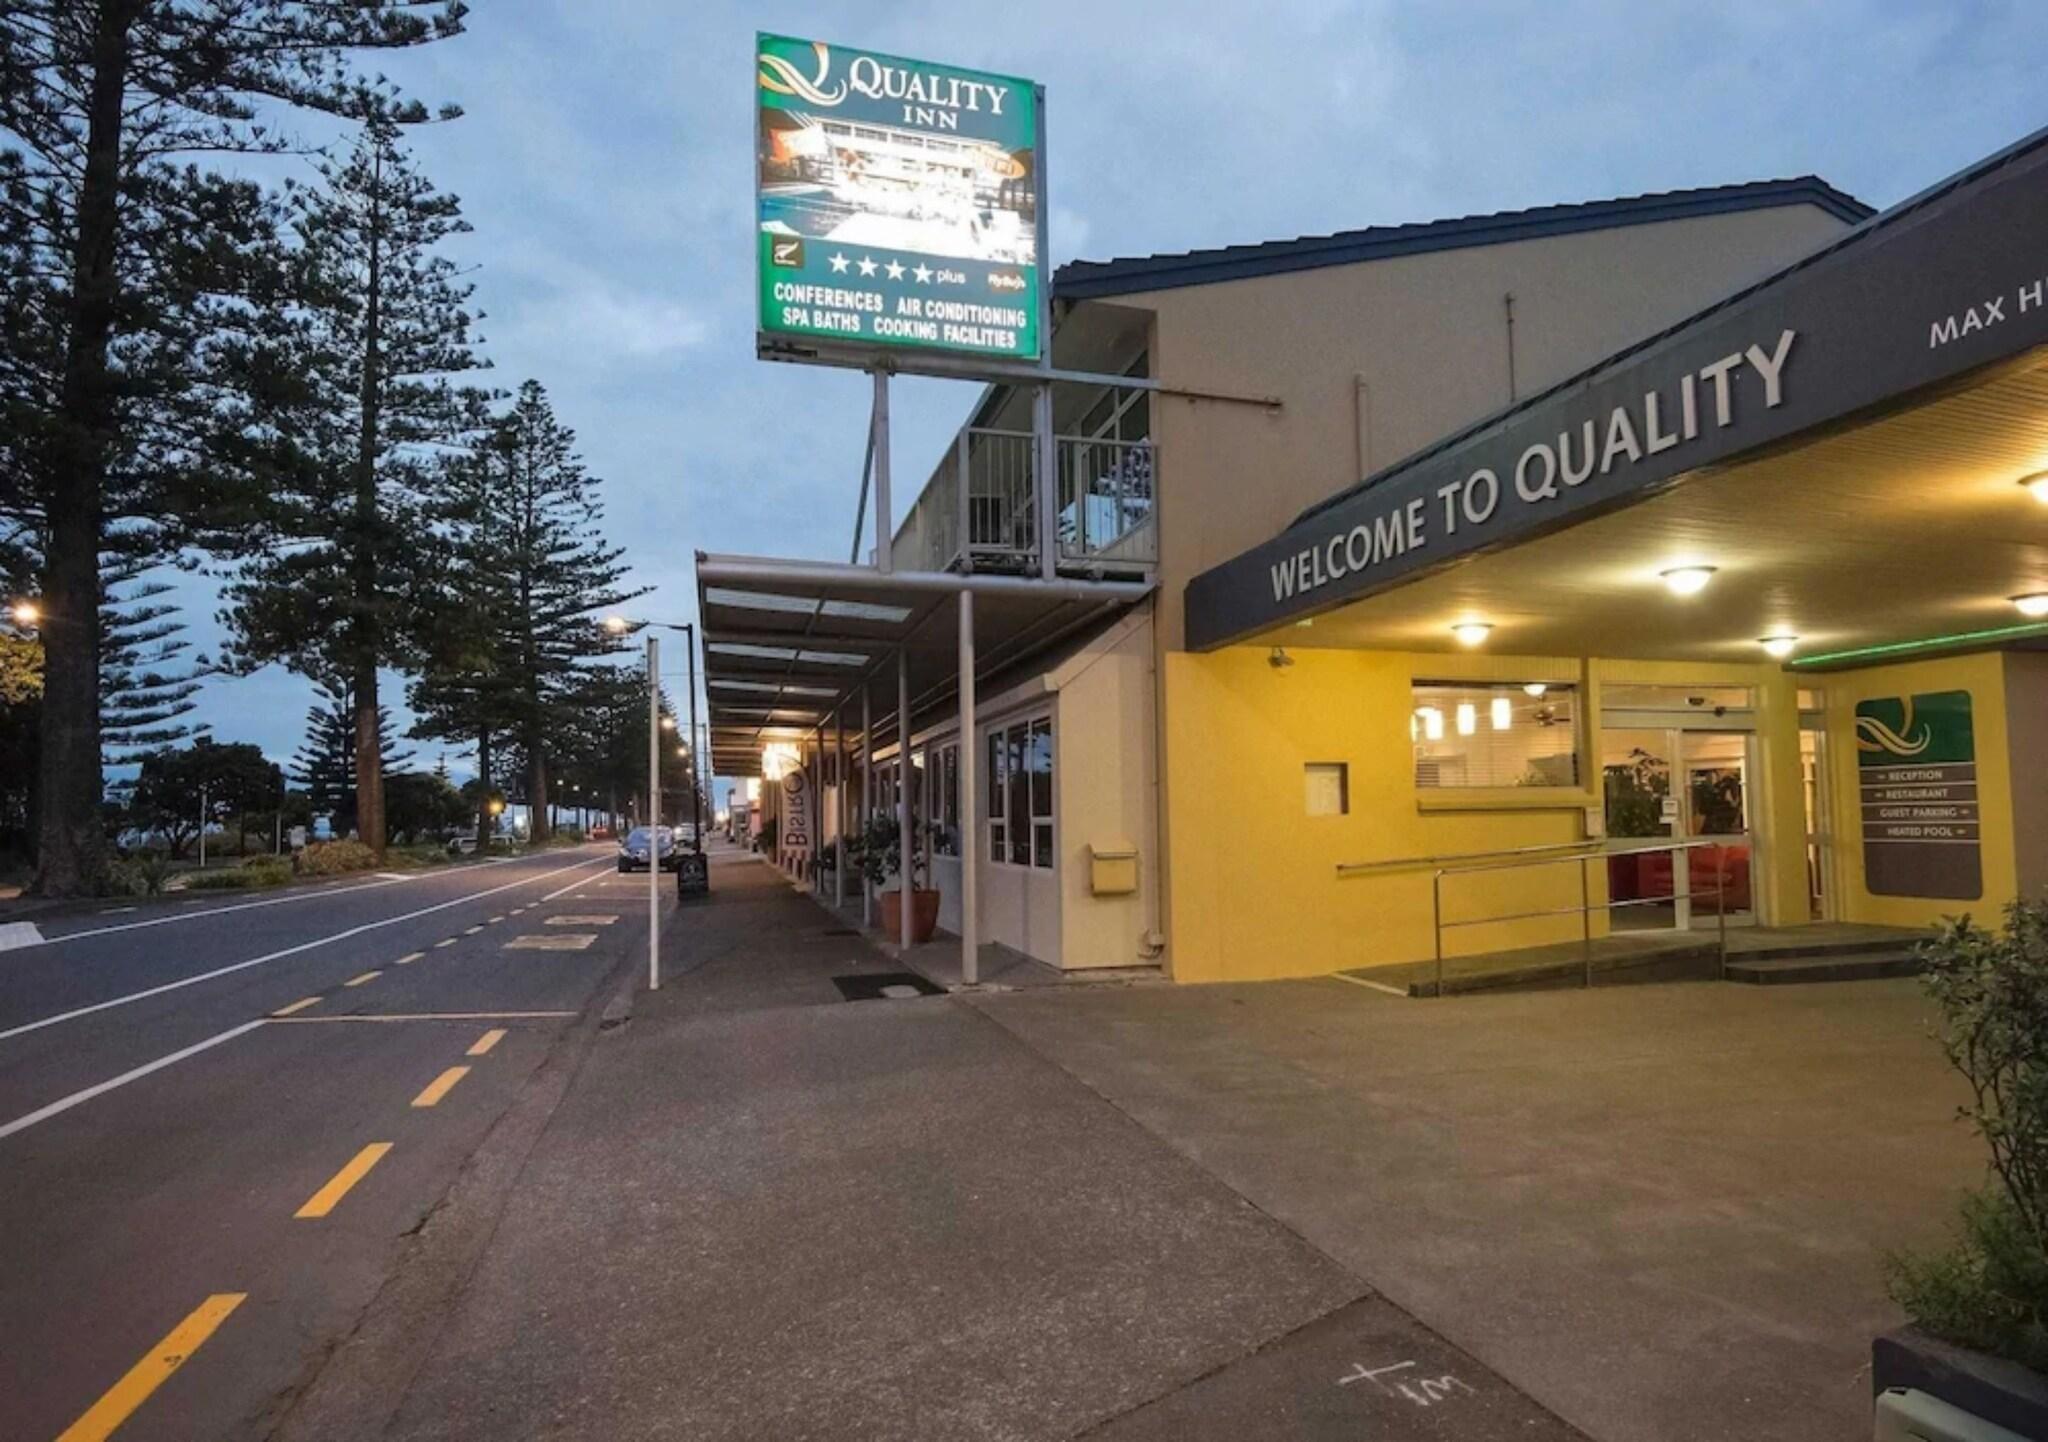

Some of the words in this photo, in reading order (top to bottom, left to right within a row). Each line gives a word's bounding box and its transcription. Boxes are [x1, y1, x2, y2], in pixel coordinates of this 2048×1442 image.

[850, 57, 1008, 114] QUALITY
[902, 104, 959, 130] INN
[937, 269, 967, 285] plus
[774, 282, 884, 312] CONFERENCES
[897, 296, 922, 318] AIR
[925, 302, 1027, 328] CONDITIONING
[1929, 295, 2006, 350] MAX
[2017, 275, 2048, 314] H
[783, 307, 810, 328] SPA
[813, 311, 861, 333] BATHS
[873, 316, 938, 341] COOKING
[943, 324, 1017, 350] FACILITIES
[1270, 498, 1426, 602] WELCOME
[1437, 469, 1499, 535] TO
[1515, 329, 1796, 504] QUALITY
[1888, 770, 1943, 781] RECEPTION
[1886, 789, 1948, 799] RESTAURANT
[1880, 807, 1910, 818] GUEST
[1912, 807, 1957, 817] PARKING
[1887, 826, 1922, 836] HEATED
[1923, 826, 1953, 836] POOL
